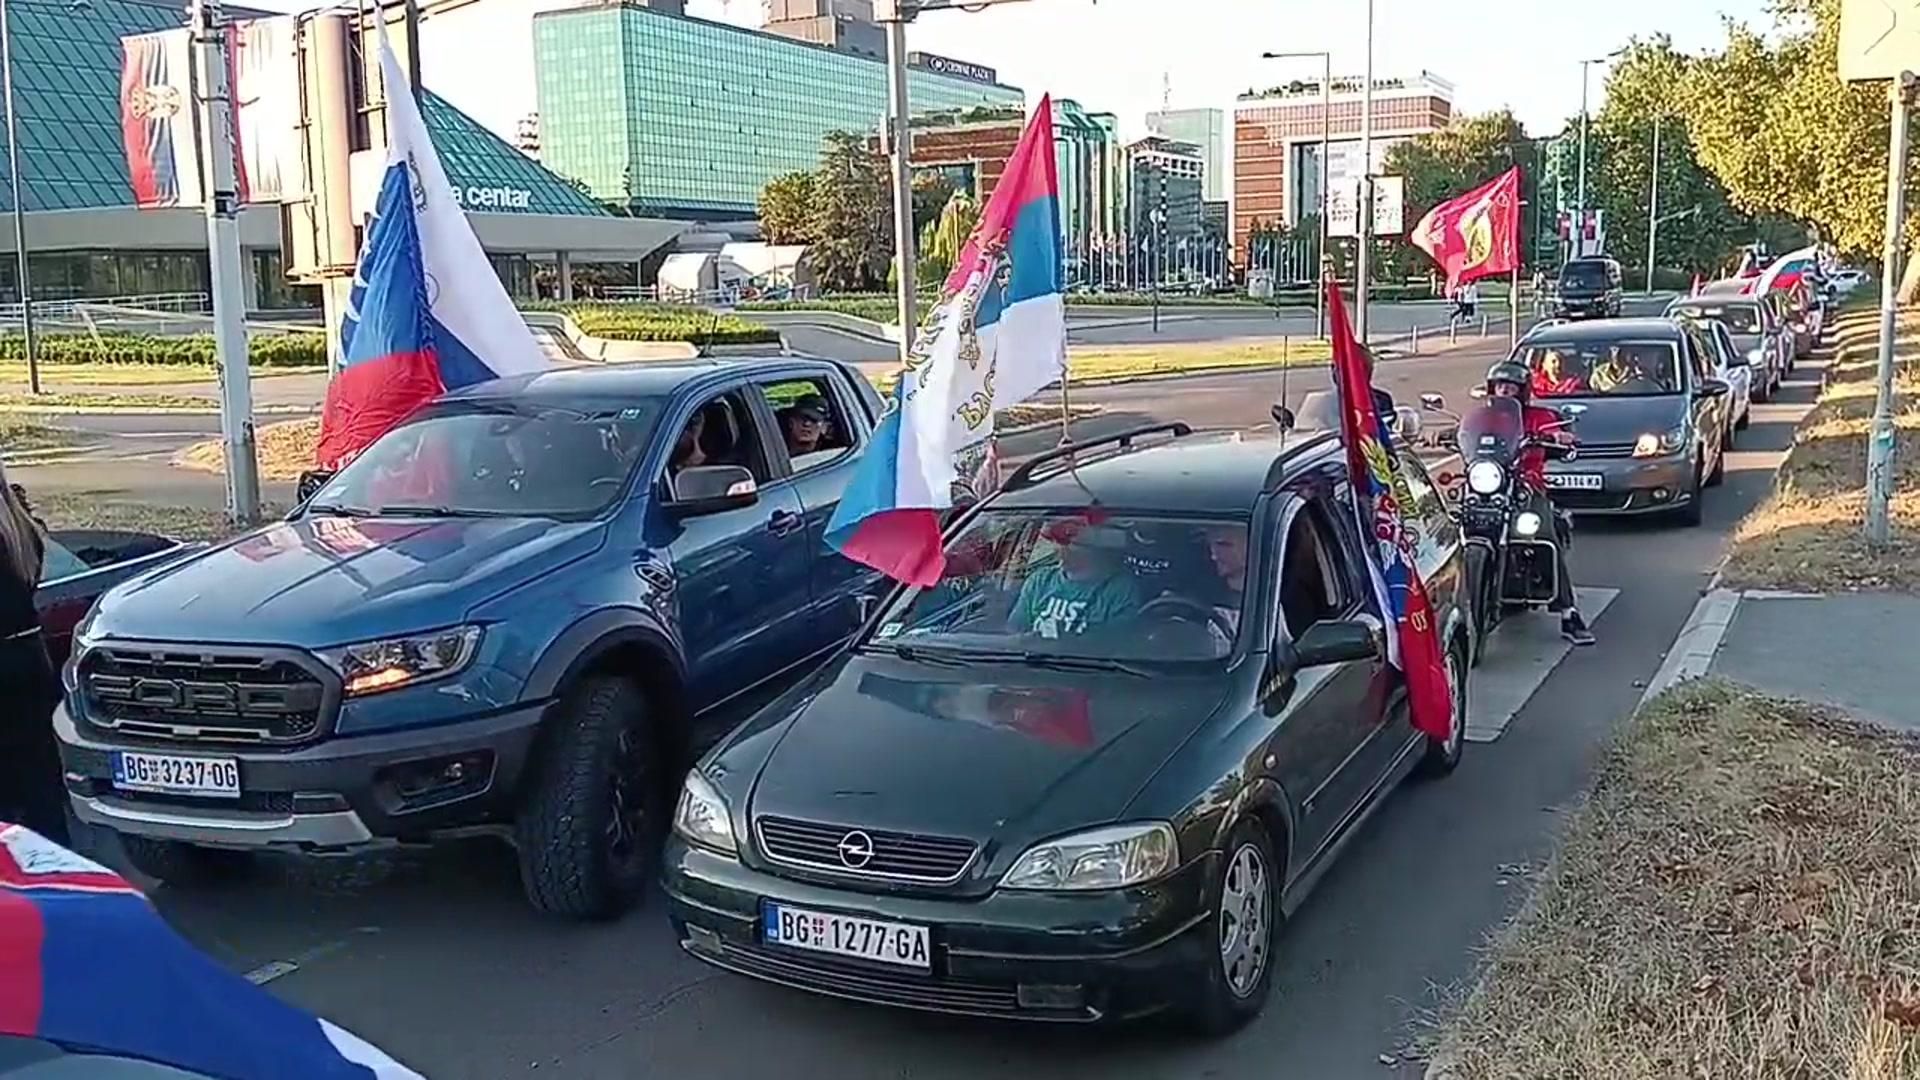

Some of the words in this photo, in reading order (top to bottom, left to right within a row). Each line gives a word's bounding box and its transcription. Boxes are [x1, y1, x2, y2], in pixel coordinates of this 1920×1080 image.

[466, 185, 532, 208] centar
[89, 671, 324, 718] FORD
[125, 755, 149, 782] BG
[782, 911, 809, 943] BG
